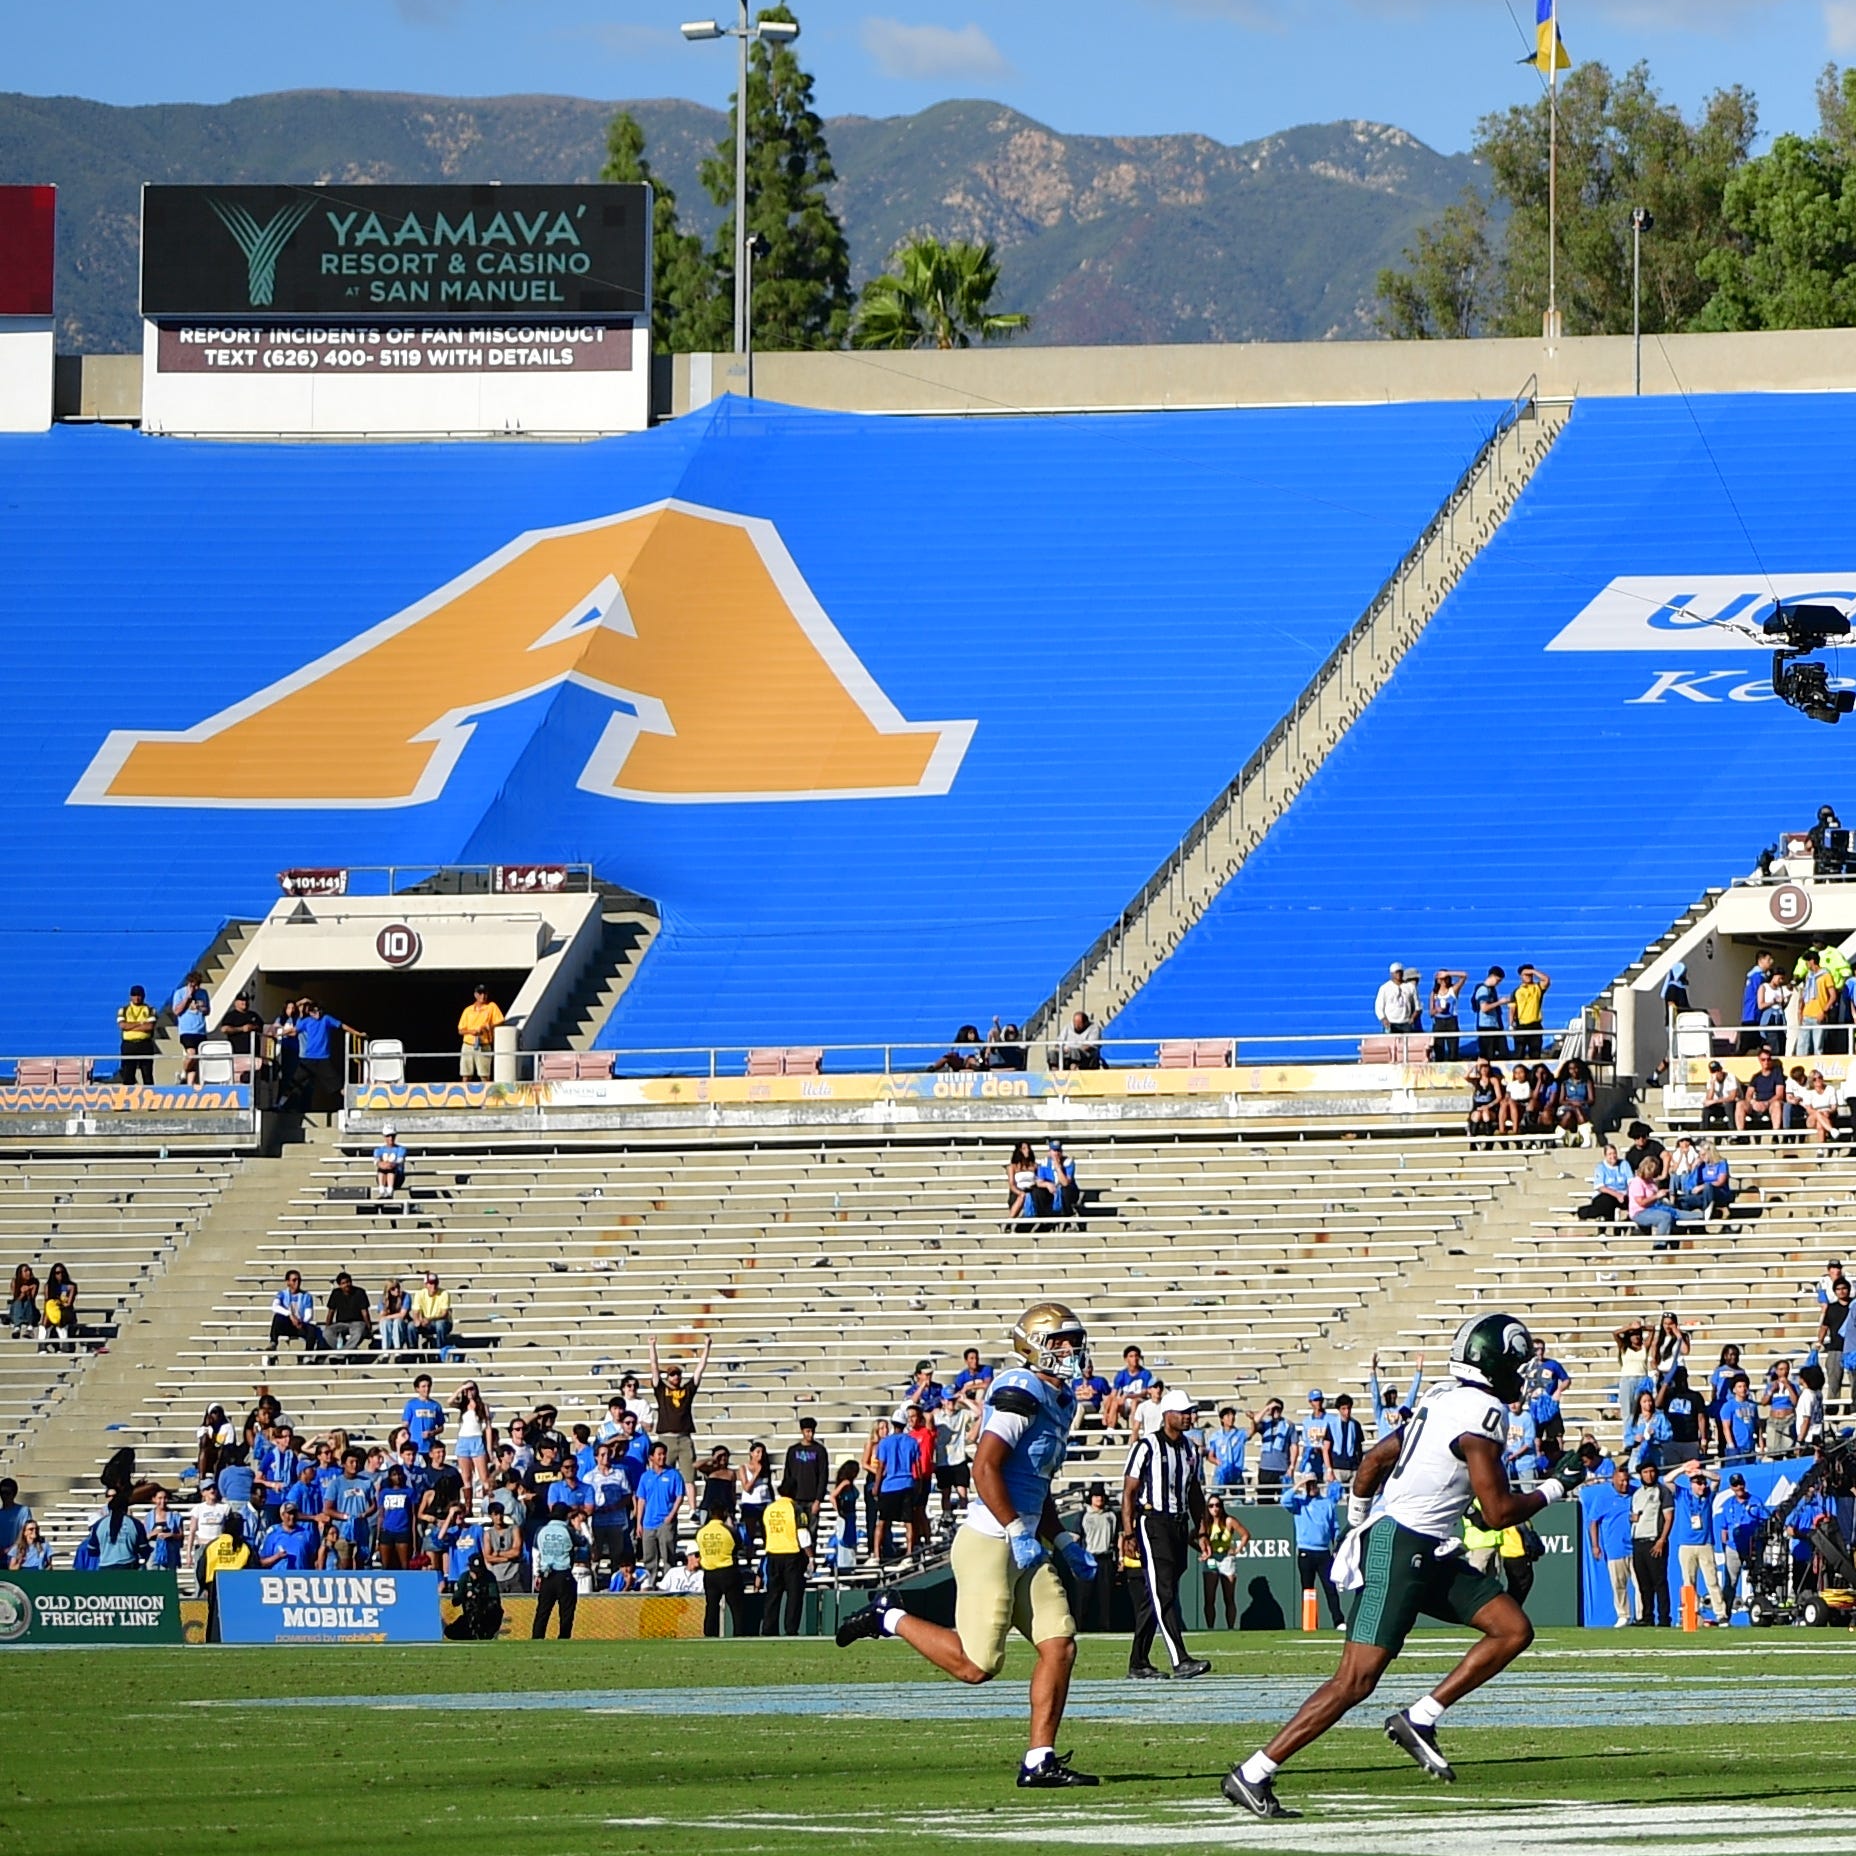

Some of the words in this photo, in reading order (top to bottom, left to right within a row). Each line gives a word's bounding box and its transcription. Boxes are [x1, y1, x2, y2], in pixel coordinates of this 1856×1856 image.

[321, 253, 438, 275] RESORT
[448, 253, 466, 275] &
[476, 253, 591, 275] CASINO
[346, 286, 360, 297] AT
[370, 280, 431, 302] SAN
[440, 280, 565, 302] MANUEL
[180, 328, 265, 344] REPORT
[270, 328, 382, 344] INCIDENTS
[387, 328, 415, 343] OF
[421, 327, 462, 343] FAN
[467, 326, 606, 343] MISCONDUCT
[204, 350, 257, 367] TEXT
[263, 349, 319, 369] (626)
[324, 350, 374, 367] 400-
[379, 350, 422, 367] 5119
[427, 350, 482, 367] WITH
[487, 349, 574, 366] DETAILS
[68, 499, 974, 808] A
[296, 876, 341, 889] 101-141
[508, 871, 545, 888] 1-41
[1780, 893, 1797, 918] 9
[385, 932, 408, 957] 10
[934, 1081, 973, 1098] our
[982, 1077, 1029, 1098] den
[1482, 1408, 1500, 1433] 0
[260, 1576, 397, 1605] BRUINS
[35, 1597, 70, 1611] OLD
[75, 1596, 164, 1611] DOMINION
[41, 1612, 114, 1627] FREIGHT
[119, 1611, 160, 1626] LINE
[283, 1607, 380, 1628] MOBILE
